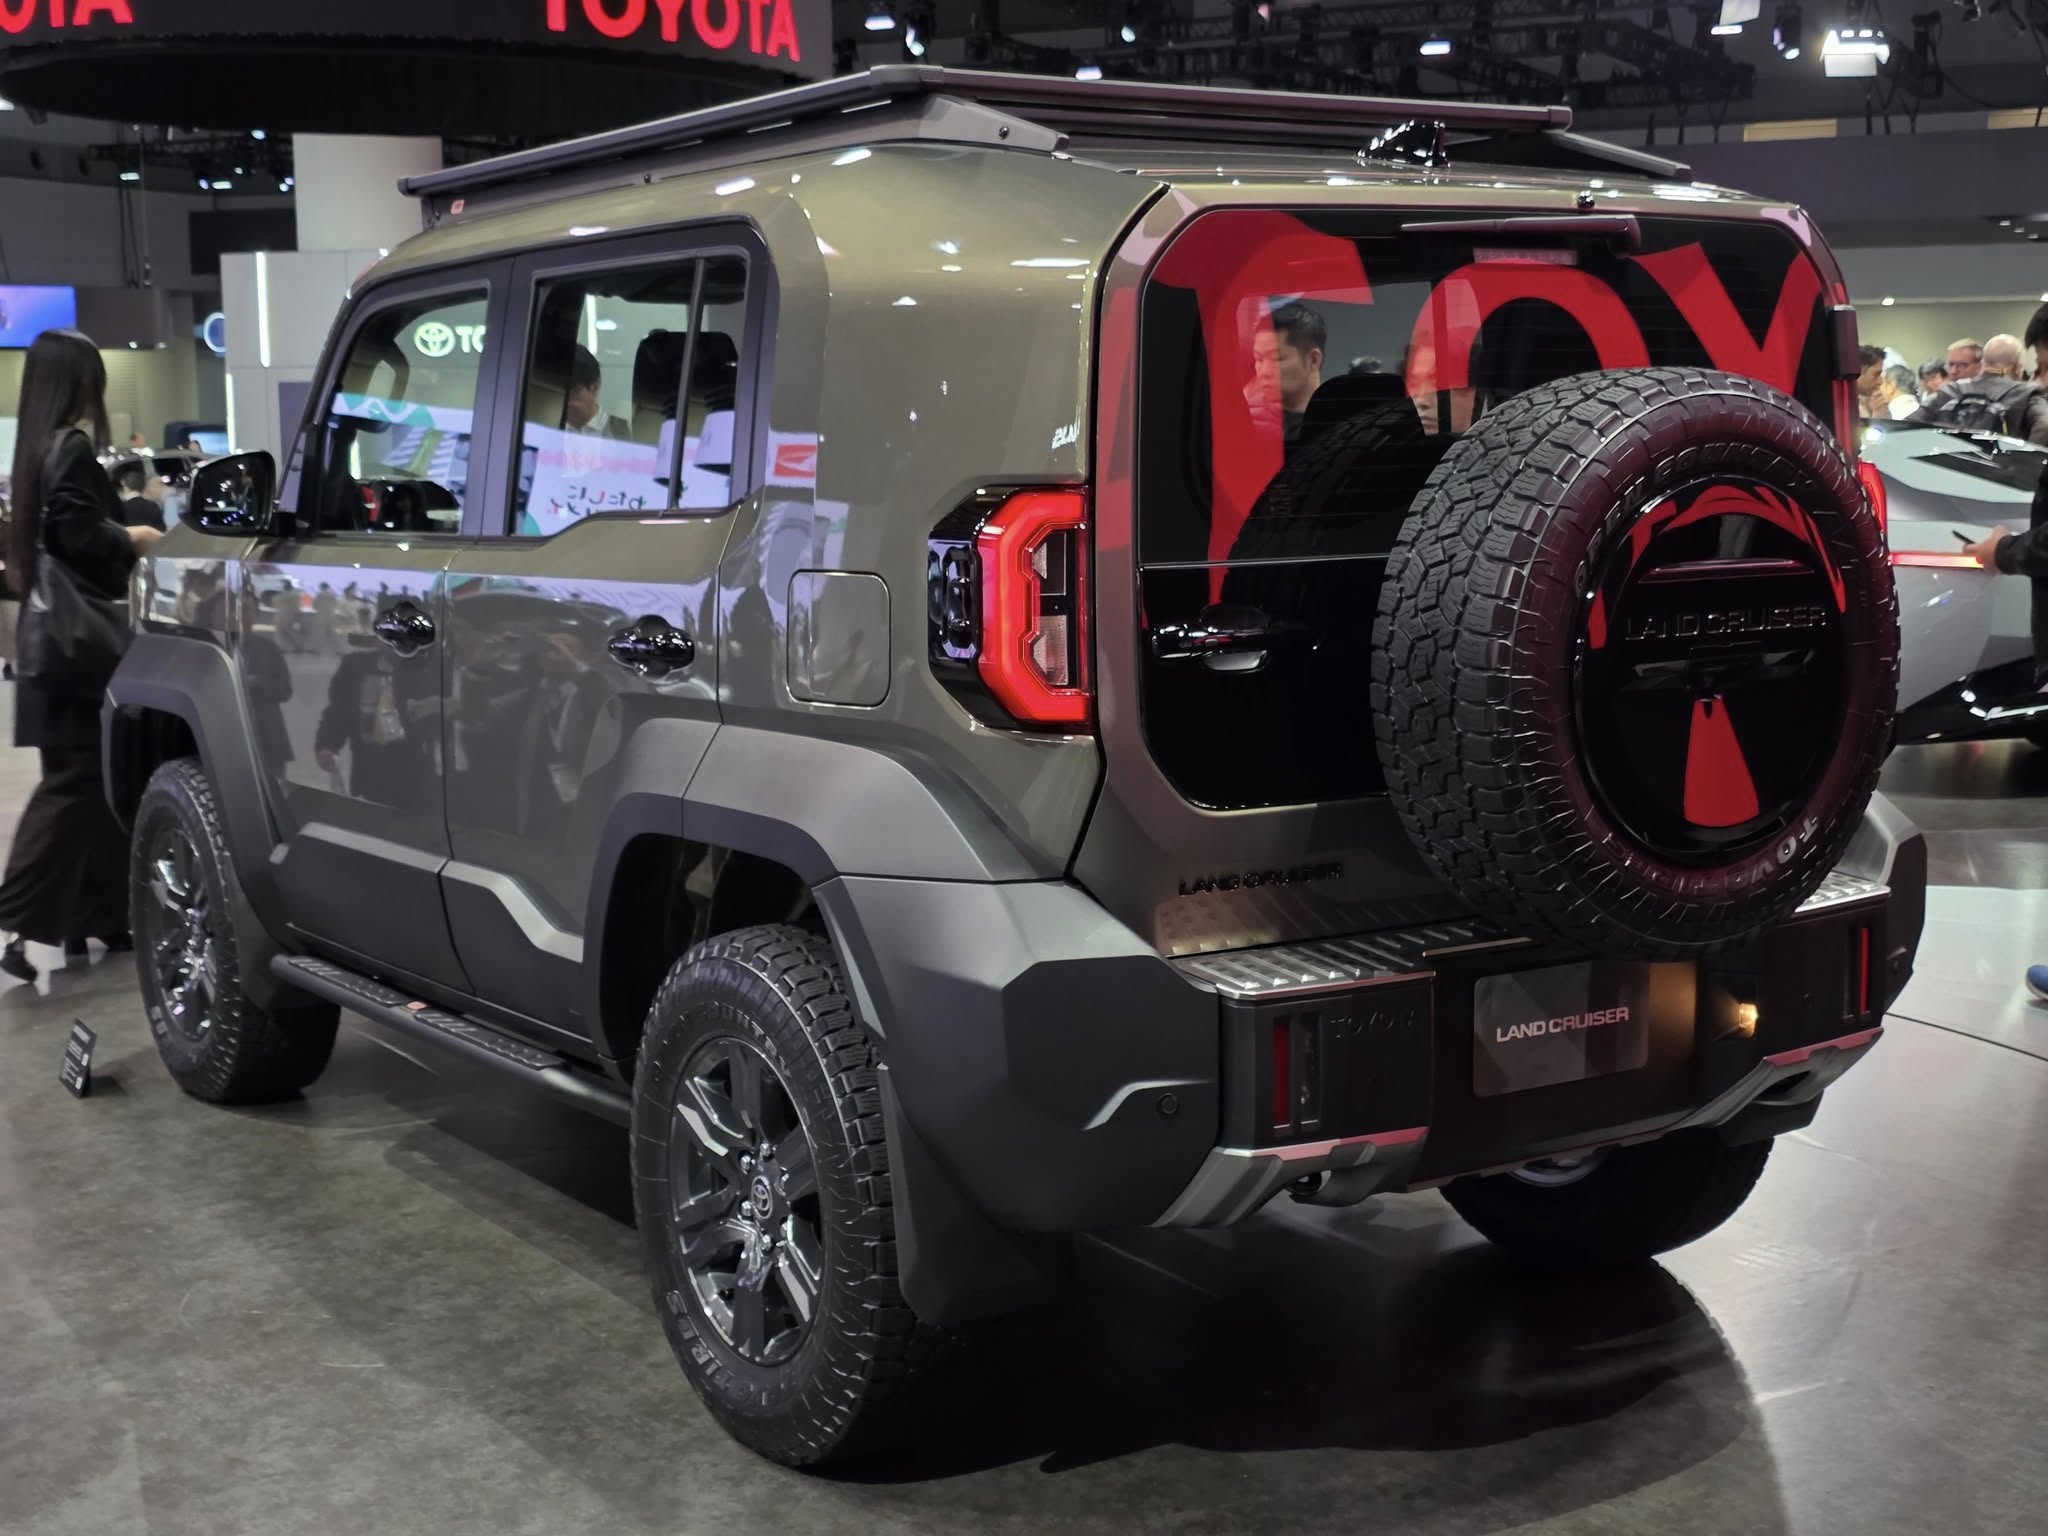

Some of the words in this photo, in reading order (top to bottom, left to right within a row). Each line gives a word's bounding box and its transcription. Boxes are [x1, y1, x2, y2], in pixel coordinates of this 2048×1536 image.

[1705, 606, 1827, 634] CRUISER
[1178, 875, 1241, 896] LAND
[1496, 1021, 1546, 1043] LAND
[1549, 1006, 1630, 1035] CRUISER
